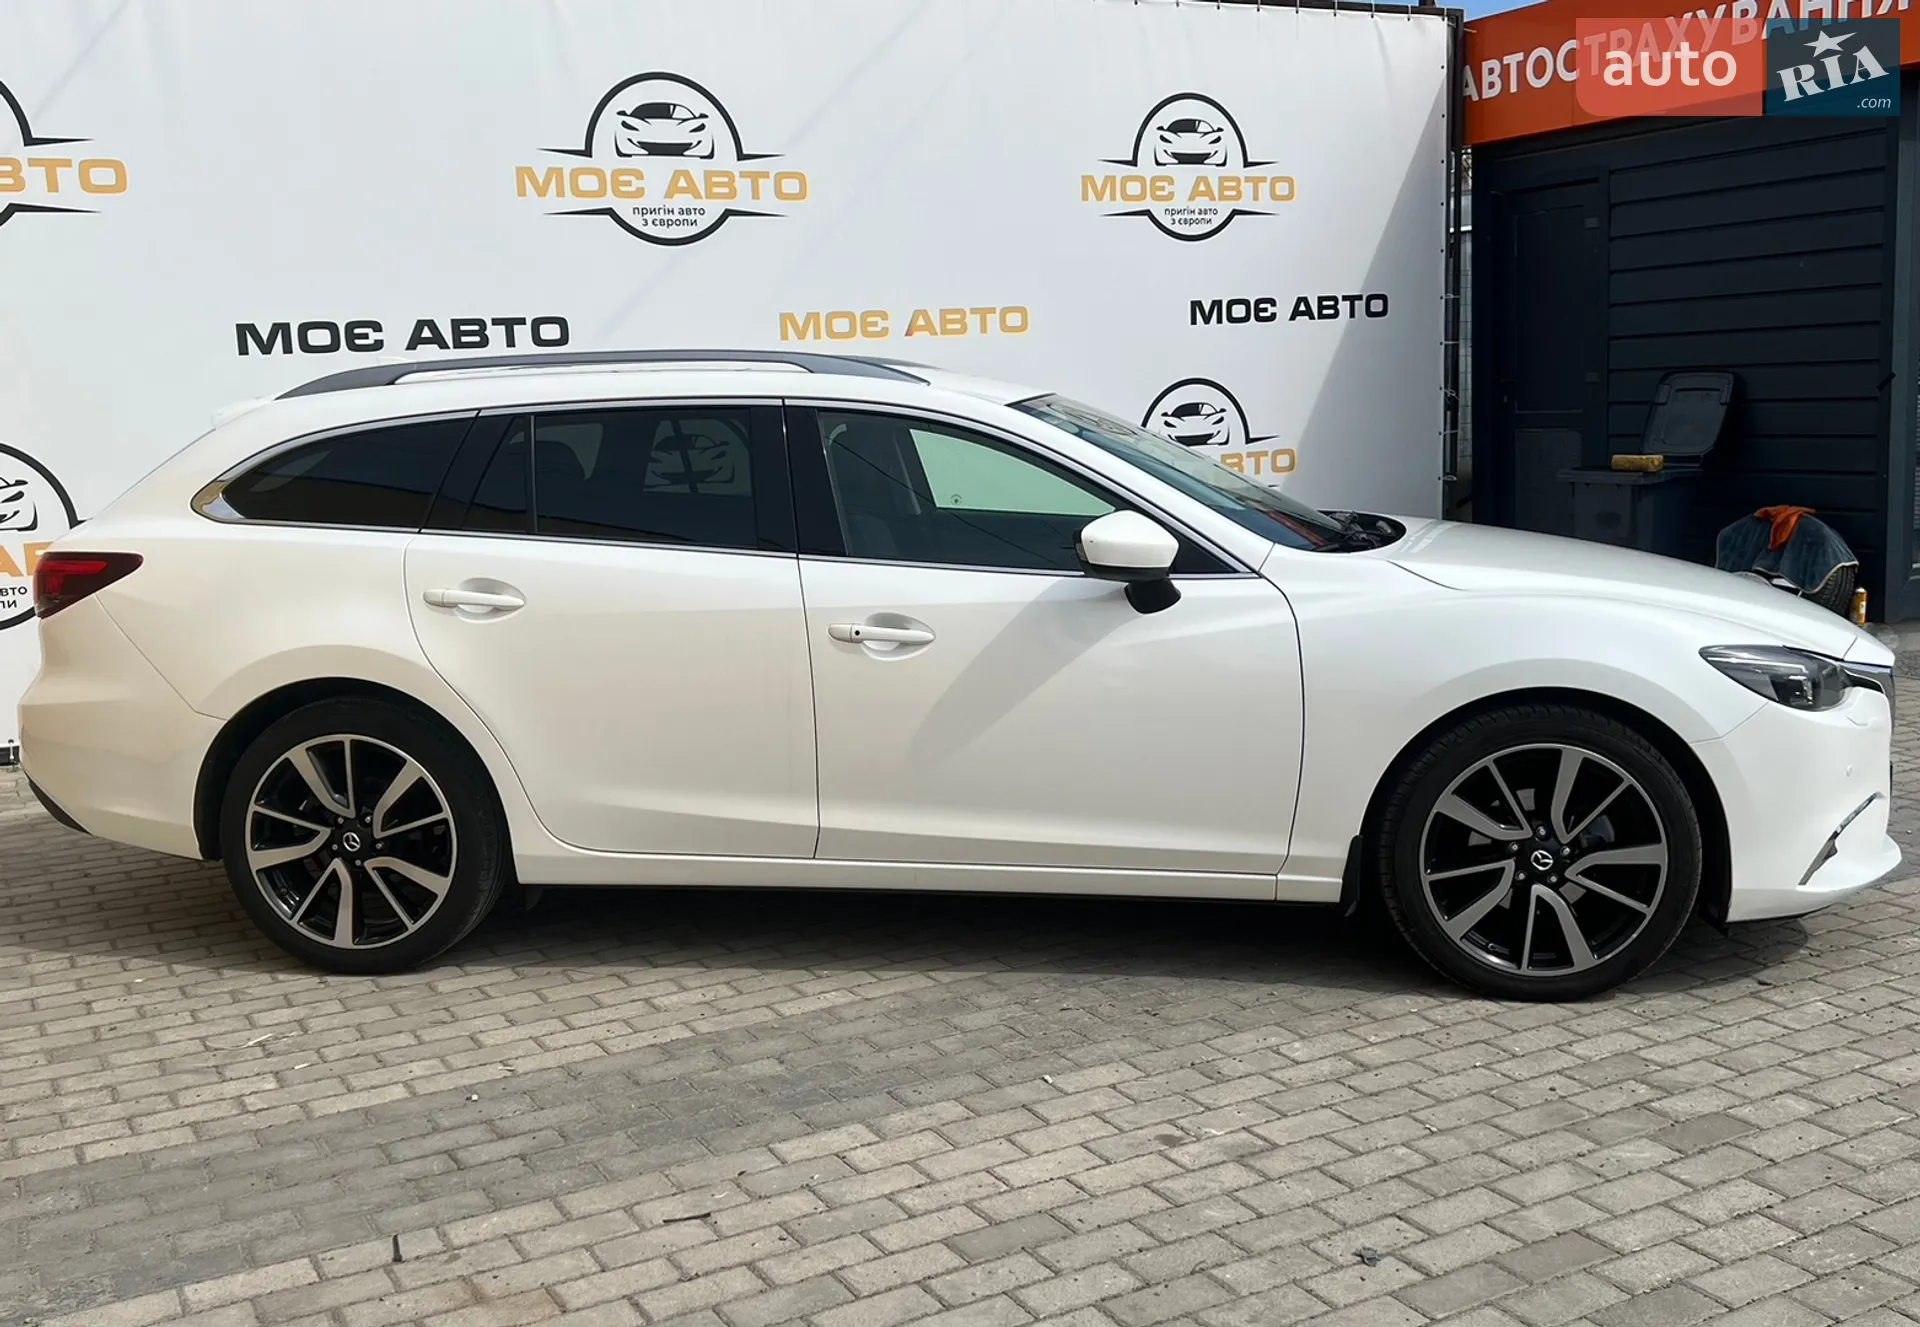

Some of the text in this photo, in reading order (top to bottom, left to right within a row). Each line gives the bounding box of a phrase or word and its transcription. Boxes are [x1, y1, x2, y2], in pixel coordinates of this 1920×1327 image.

[0, 157, 128, 194] ВТО
[514, 166, 808, 201] МОЄ АВТО
[1080, 174, 1296, 202] МОЄ АВТО
[632, 204, 706, 217] пригін авто
[651, 217, 699, 228] європи
[1164, 206, 1219, 218] пригін авто
[1178, 217, 1213, 227] європи
[1190, 293, 1389, 326] МОЄ АВТО
[235, 316, 570, 356] МОЄ АВТО
[779, 306, 1028, 341] МОЄ АВТО
[1220, 448, 1296, 475] ВТО
[0, 586, 28, 597] вто
